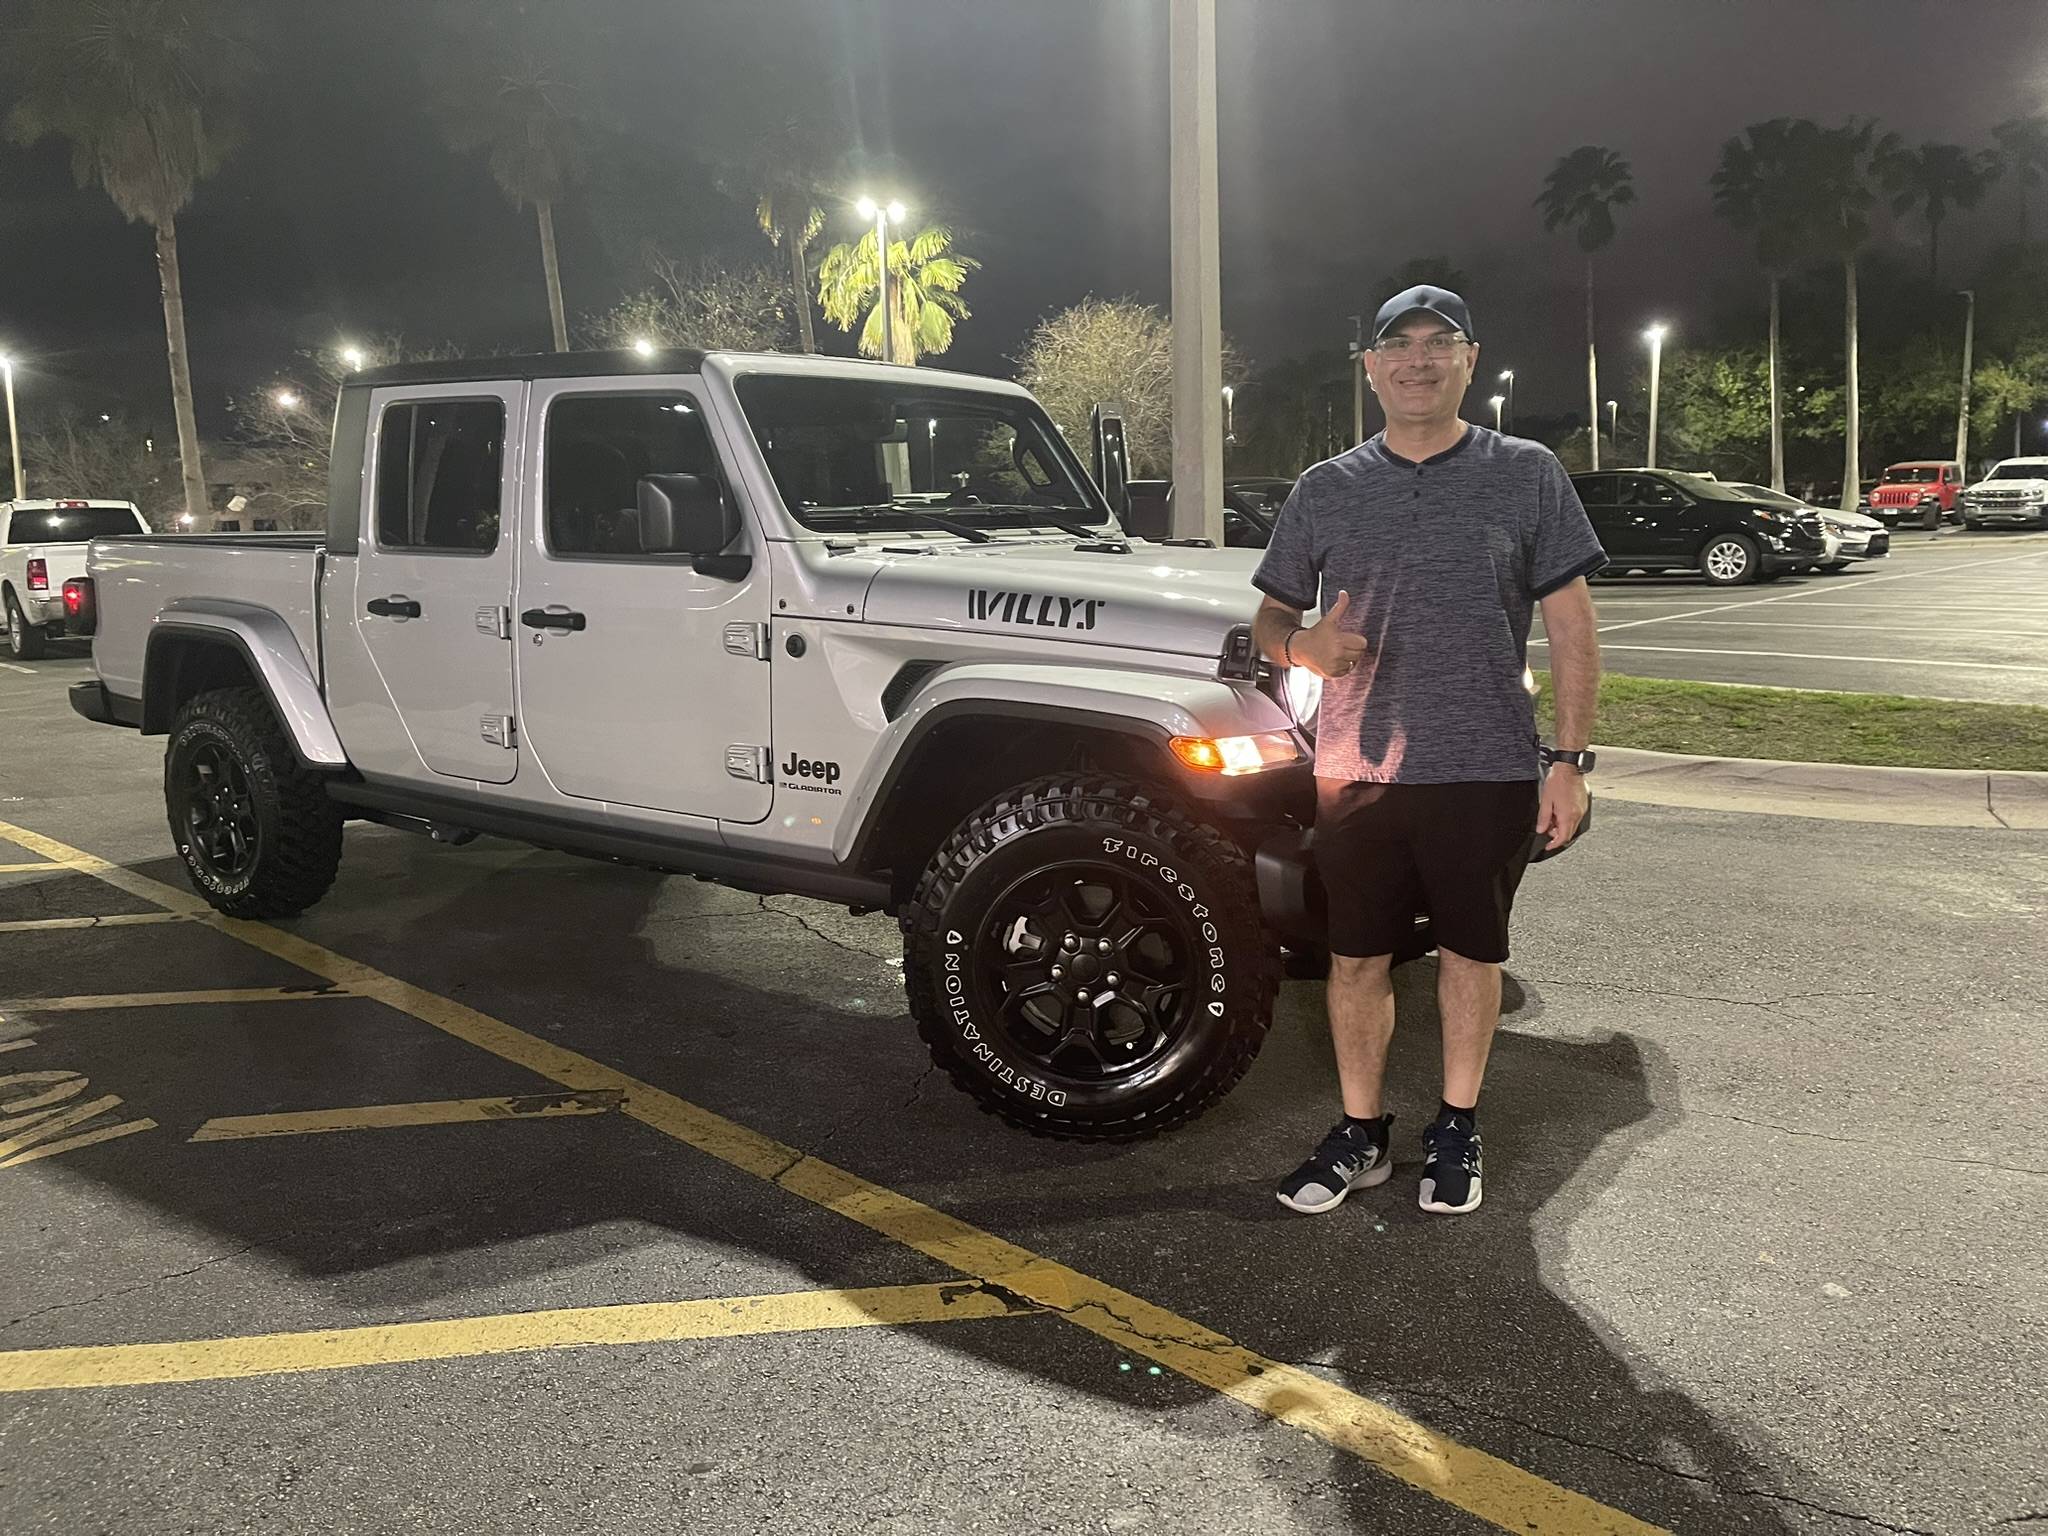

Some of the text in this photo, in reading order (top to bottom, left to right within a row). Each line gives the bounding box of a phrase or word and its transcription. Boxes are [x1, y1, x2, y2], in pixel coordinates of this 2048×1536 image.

[968, 589, 1106, 630] WILLYS
[782, 752, 840, 784] Jeep
[788, 783, 842, 795] GLADIATOR
[945, 952, 1067, 1107] DESTINATION
